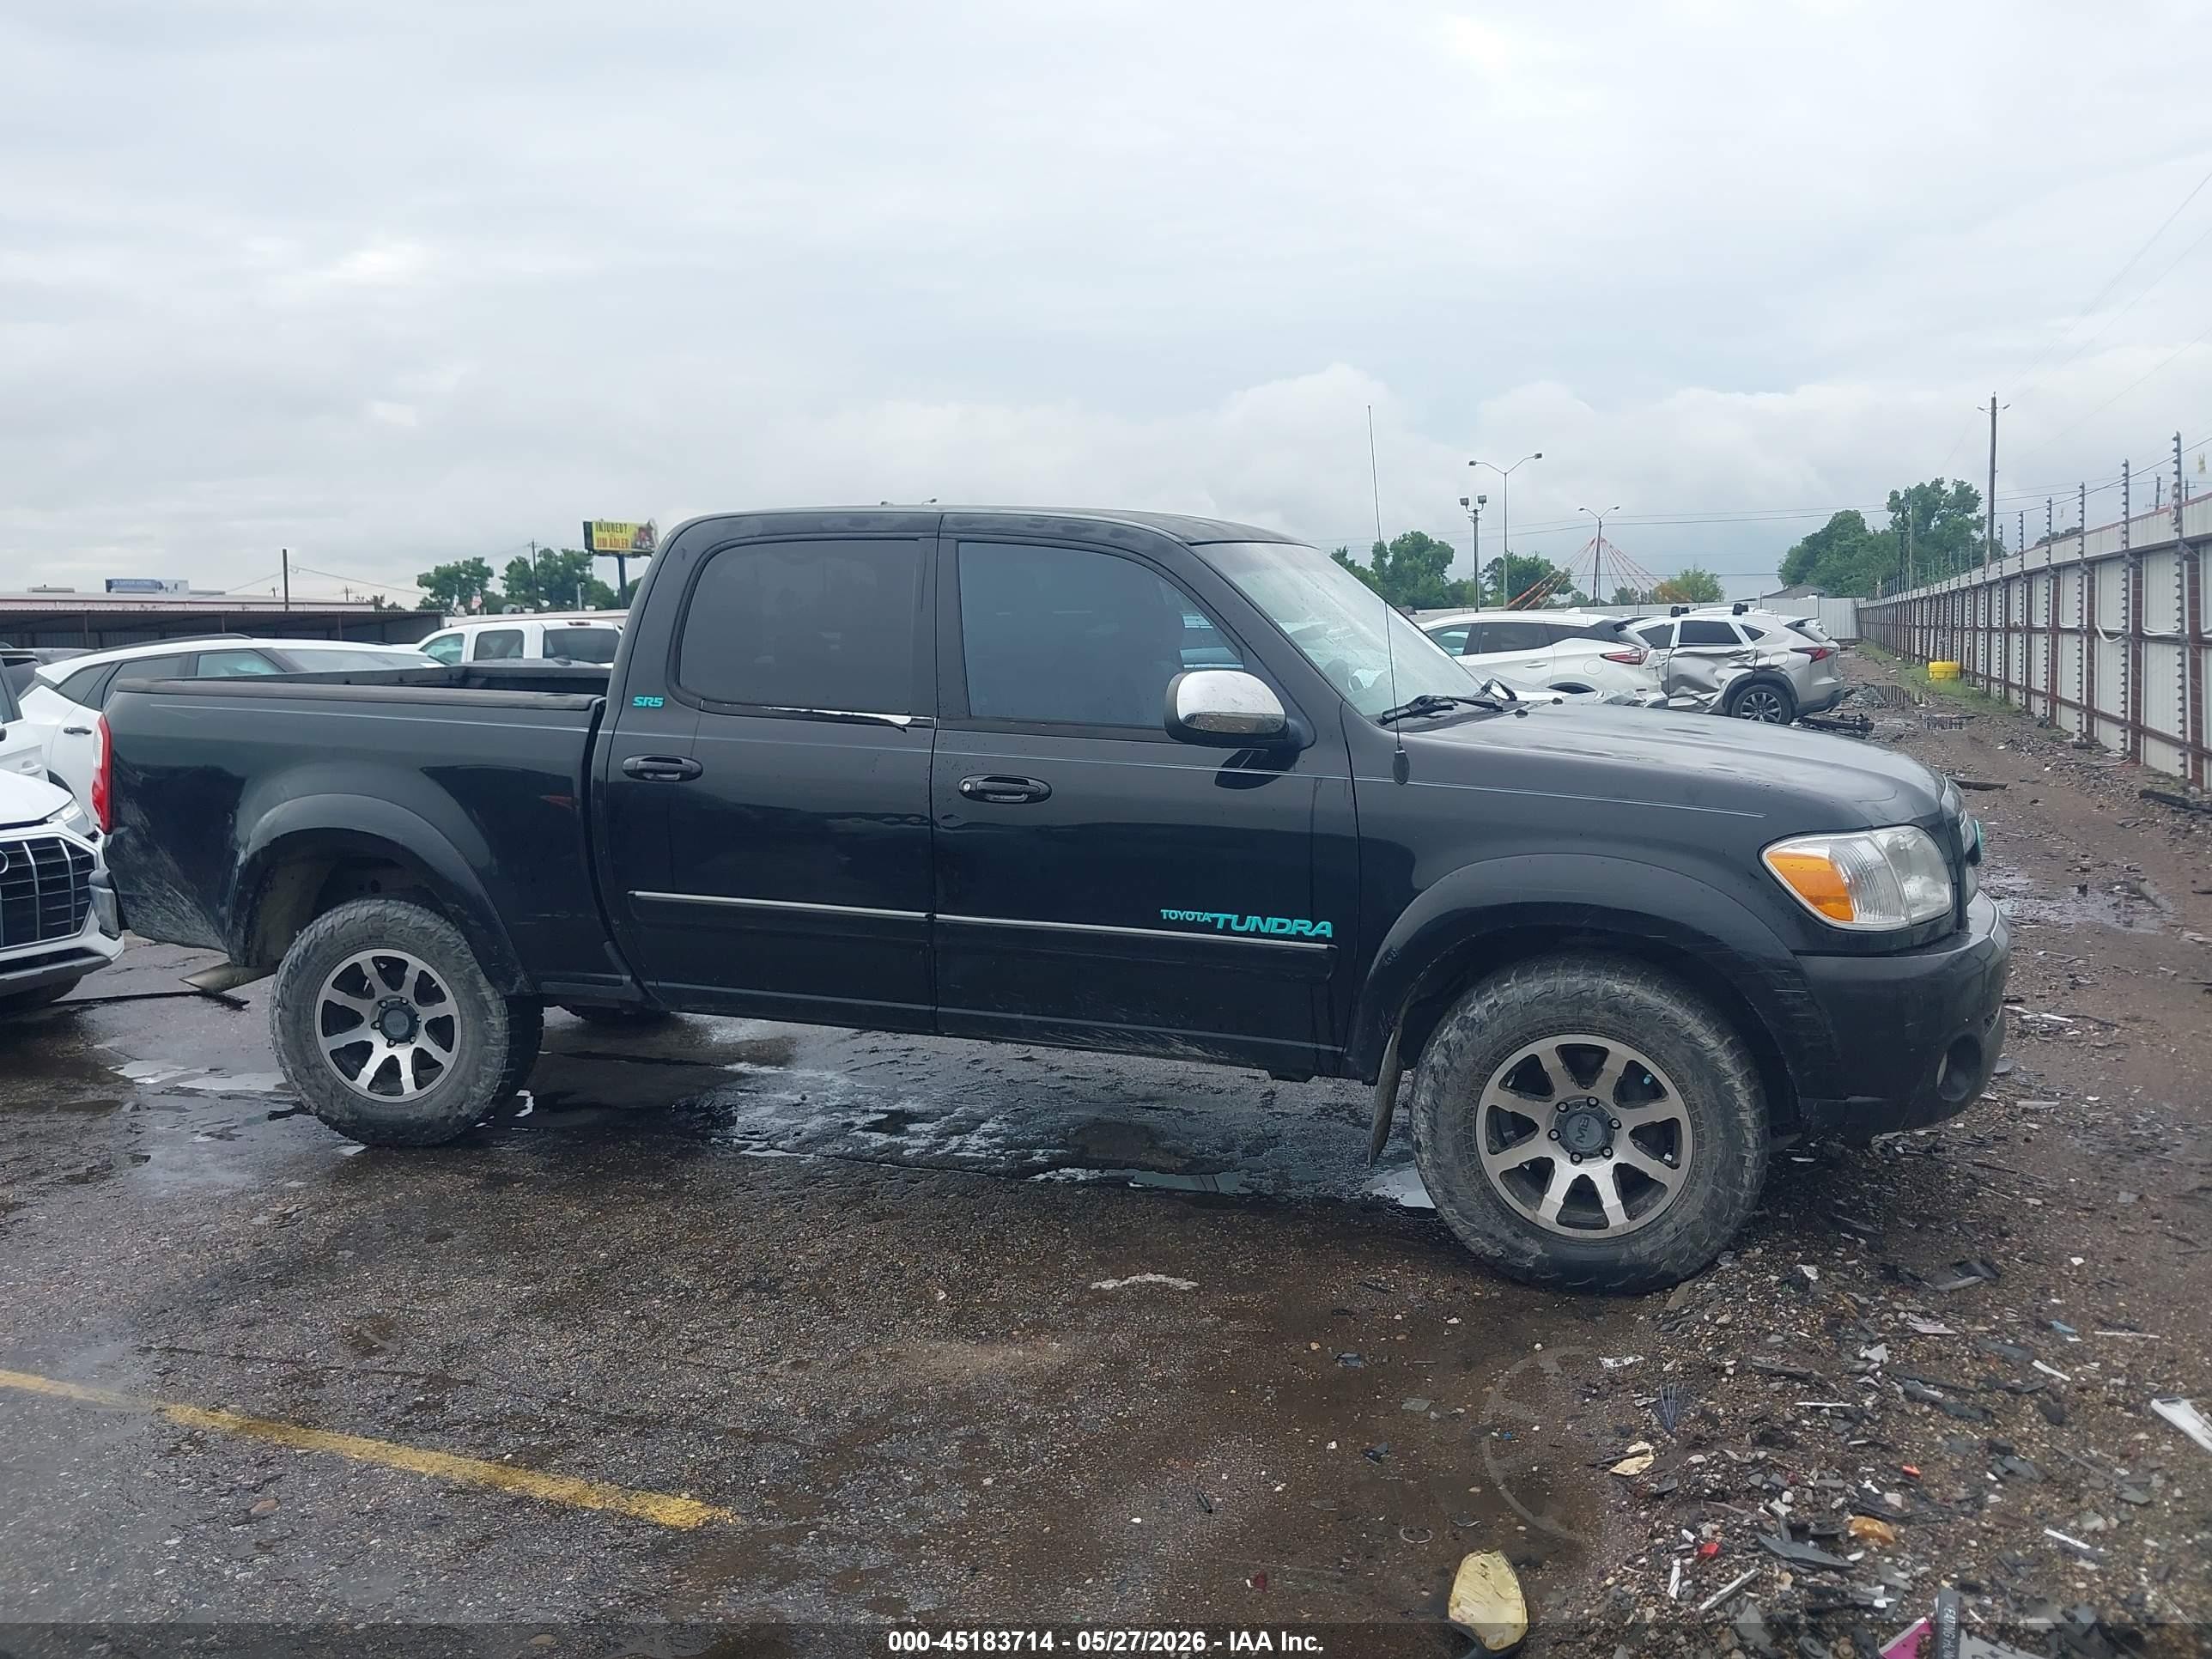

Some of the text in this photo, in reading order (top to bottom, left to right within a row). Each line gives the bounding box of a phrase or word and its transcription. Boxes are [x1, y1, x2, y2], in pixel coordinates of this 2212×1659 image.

[633, 696, 664, 707] SR5
[1160, 909, 1333, 938] TOYOTA TUNDRA
